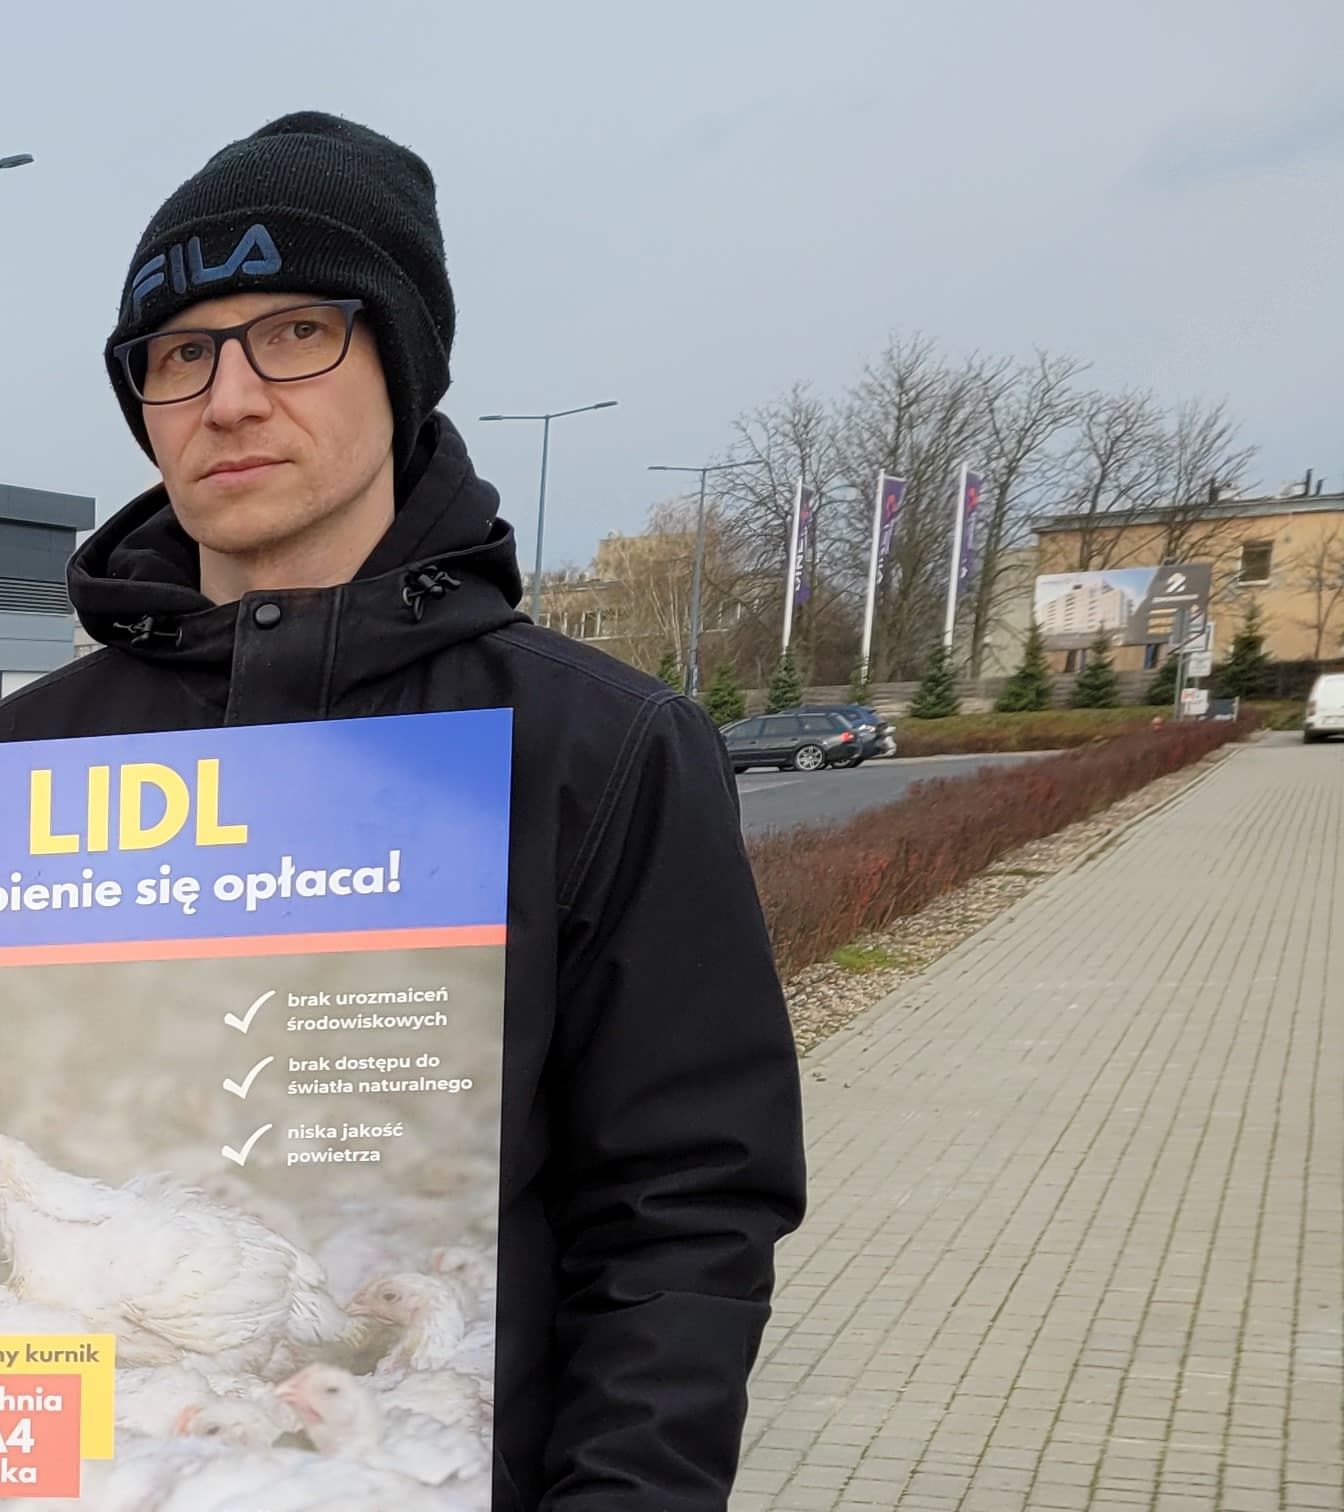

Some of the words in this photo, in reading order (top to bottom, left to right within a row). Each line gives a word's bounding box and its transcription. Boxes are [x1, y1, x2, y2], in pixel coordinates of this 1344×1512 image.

[132, 223, 282, 321] FILA
[29, 758, 248, 855] LIDL
[135, 864, 200, 914] się
[213, 850, 401, 911] opłaca!
[288, 991, 331, 1008] brak
[336, 986, 449, 1006] urozmaiceń
[287, 1011, 448, 1031] środowiskowych
[288, 1056, 330, 1072] brak
[335, 1055, 411, 1073] dostępu
[415, 1053, 441, 1068] do
[287, 1078, 353, 1095] światła
[358, 1077, 473, 1094] naturalnego
[287, 1124, 338, 1140] niska
[339, 1122, 404, 1141] jakość
[287, 1148, 381, 1166] powietrza
[25, 1344, 100, 1363] kurnik
